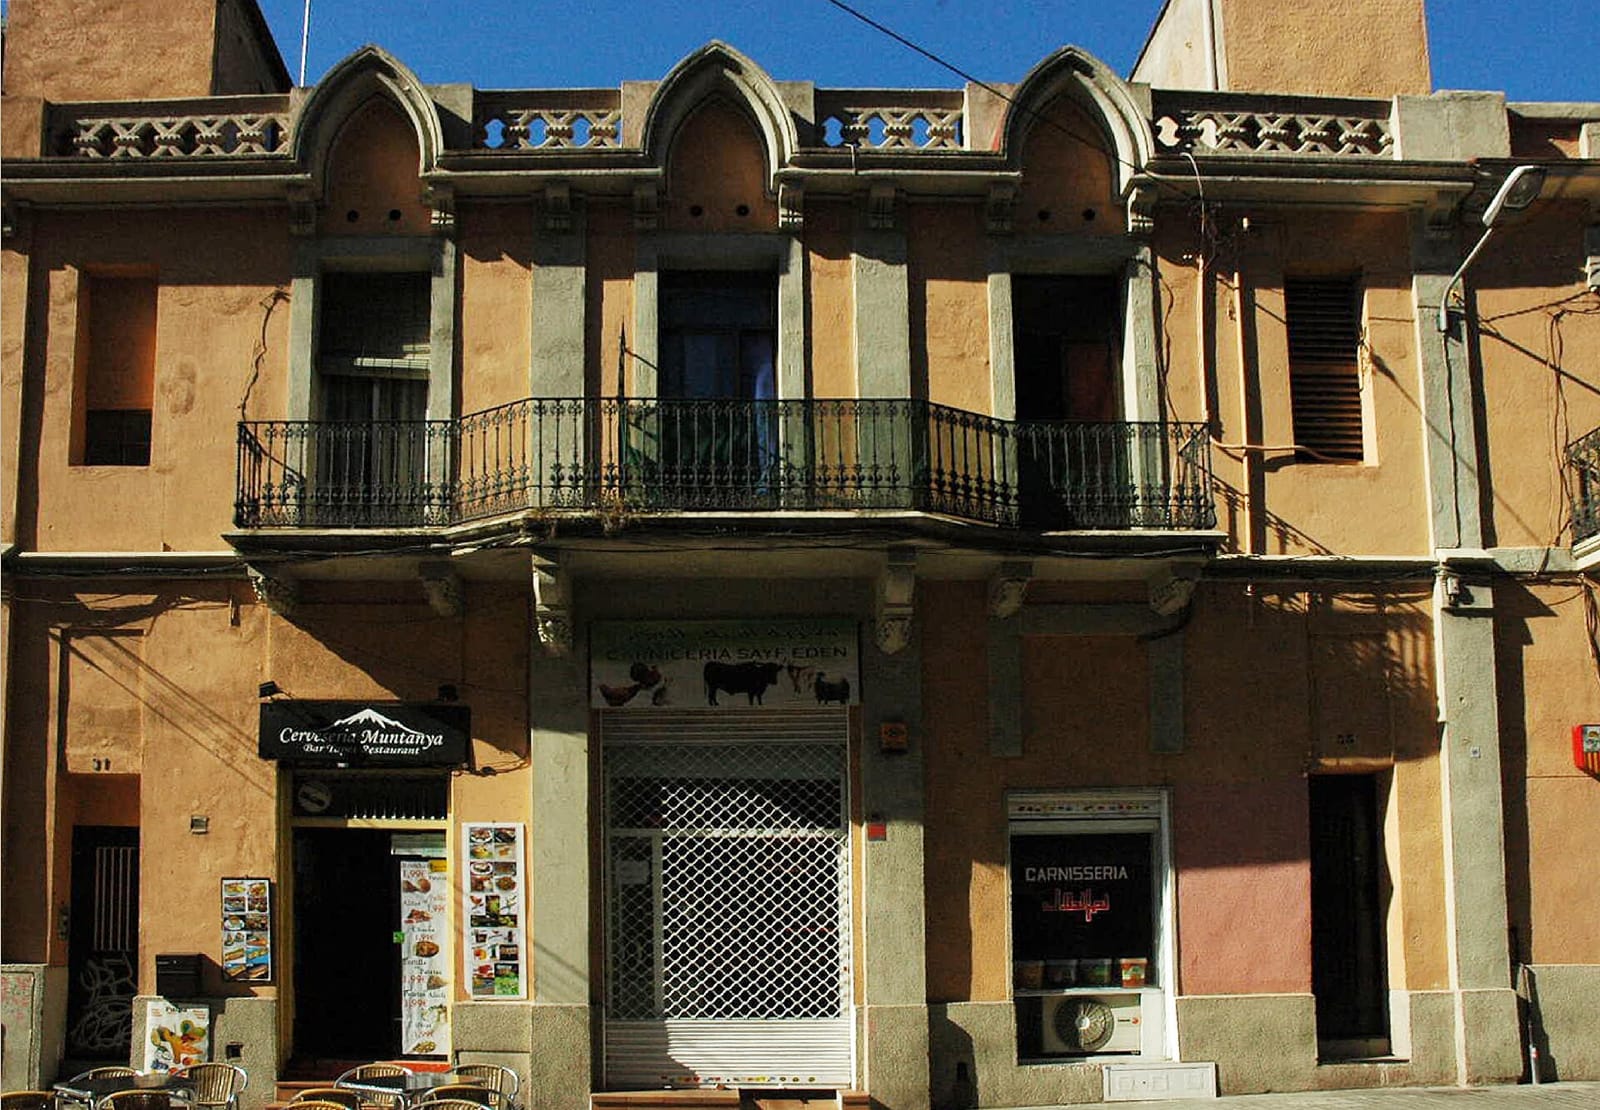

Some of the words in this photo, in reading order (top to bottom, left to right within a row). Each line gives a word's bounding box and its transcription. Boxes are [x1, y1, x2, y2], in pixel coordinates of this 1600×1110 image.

[792, 647, 847, 658] EDEN
[360, 729, 444, 750] Muntanya
[303, 743, 324, 753] Bar
[362, 743, 420, 755] Restaurant
[1025, 865, 1128, 881] CARNISSERIA
